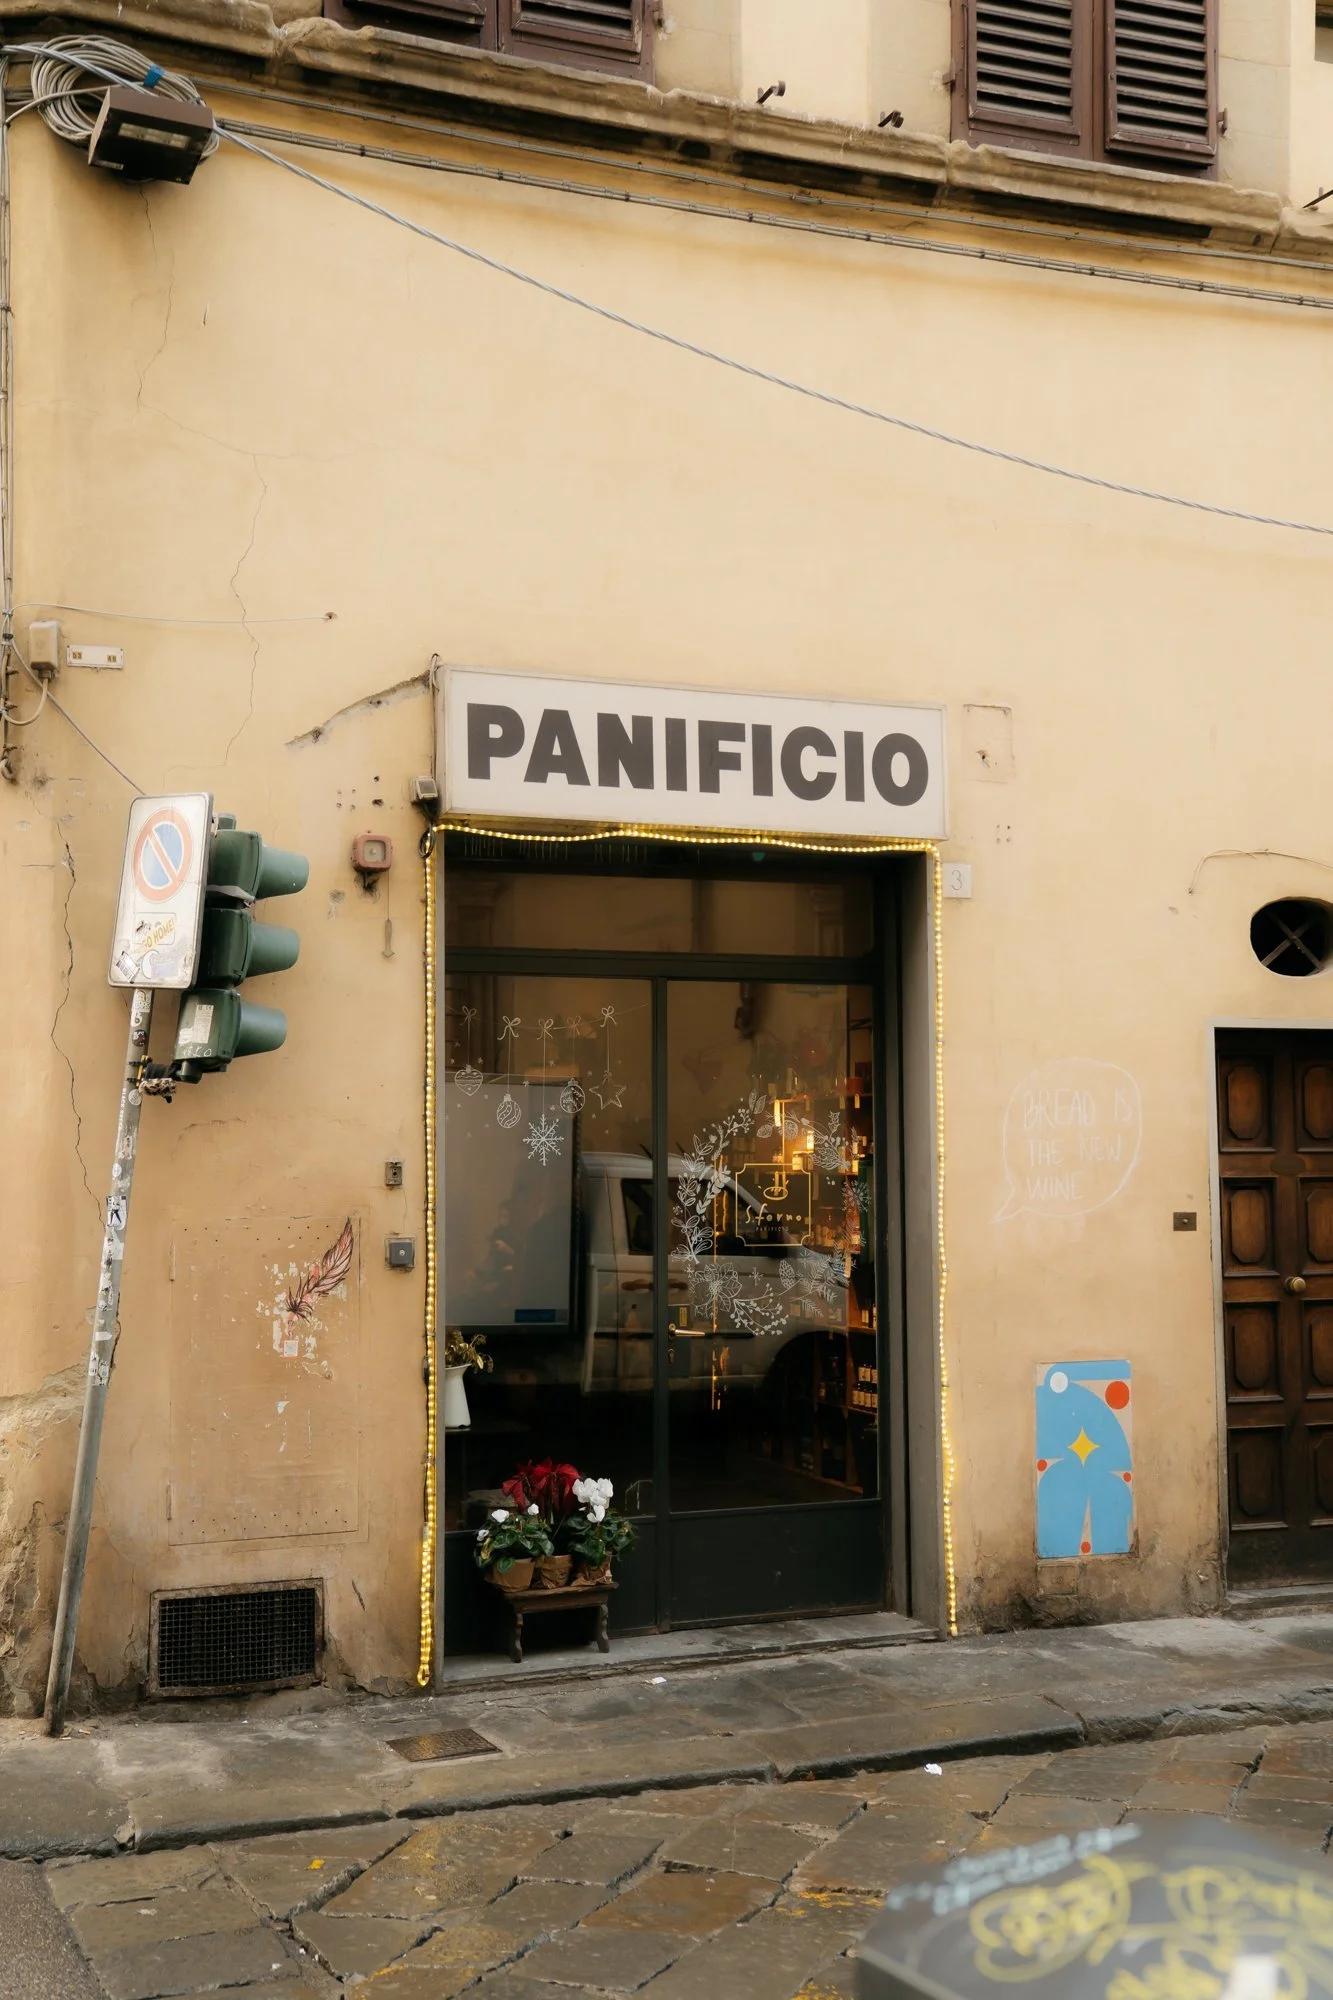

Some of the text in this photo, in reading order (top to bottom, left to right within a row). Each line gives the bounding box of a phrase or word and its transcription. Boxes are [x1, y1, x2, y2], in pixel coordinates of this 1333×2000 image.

[466, 702, 929, 807] PANIFICIO
[951, 869, 963, 891] 3
[142, 935, 153, 949] GO
[1022, 1087, 1133, 1131] BREAD IS
[1027, 1133, 1122, 1168] THE NEW
[1026, 1171, 1085, 1201] WINE
